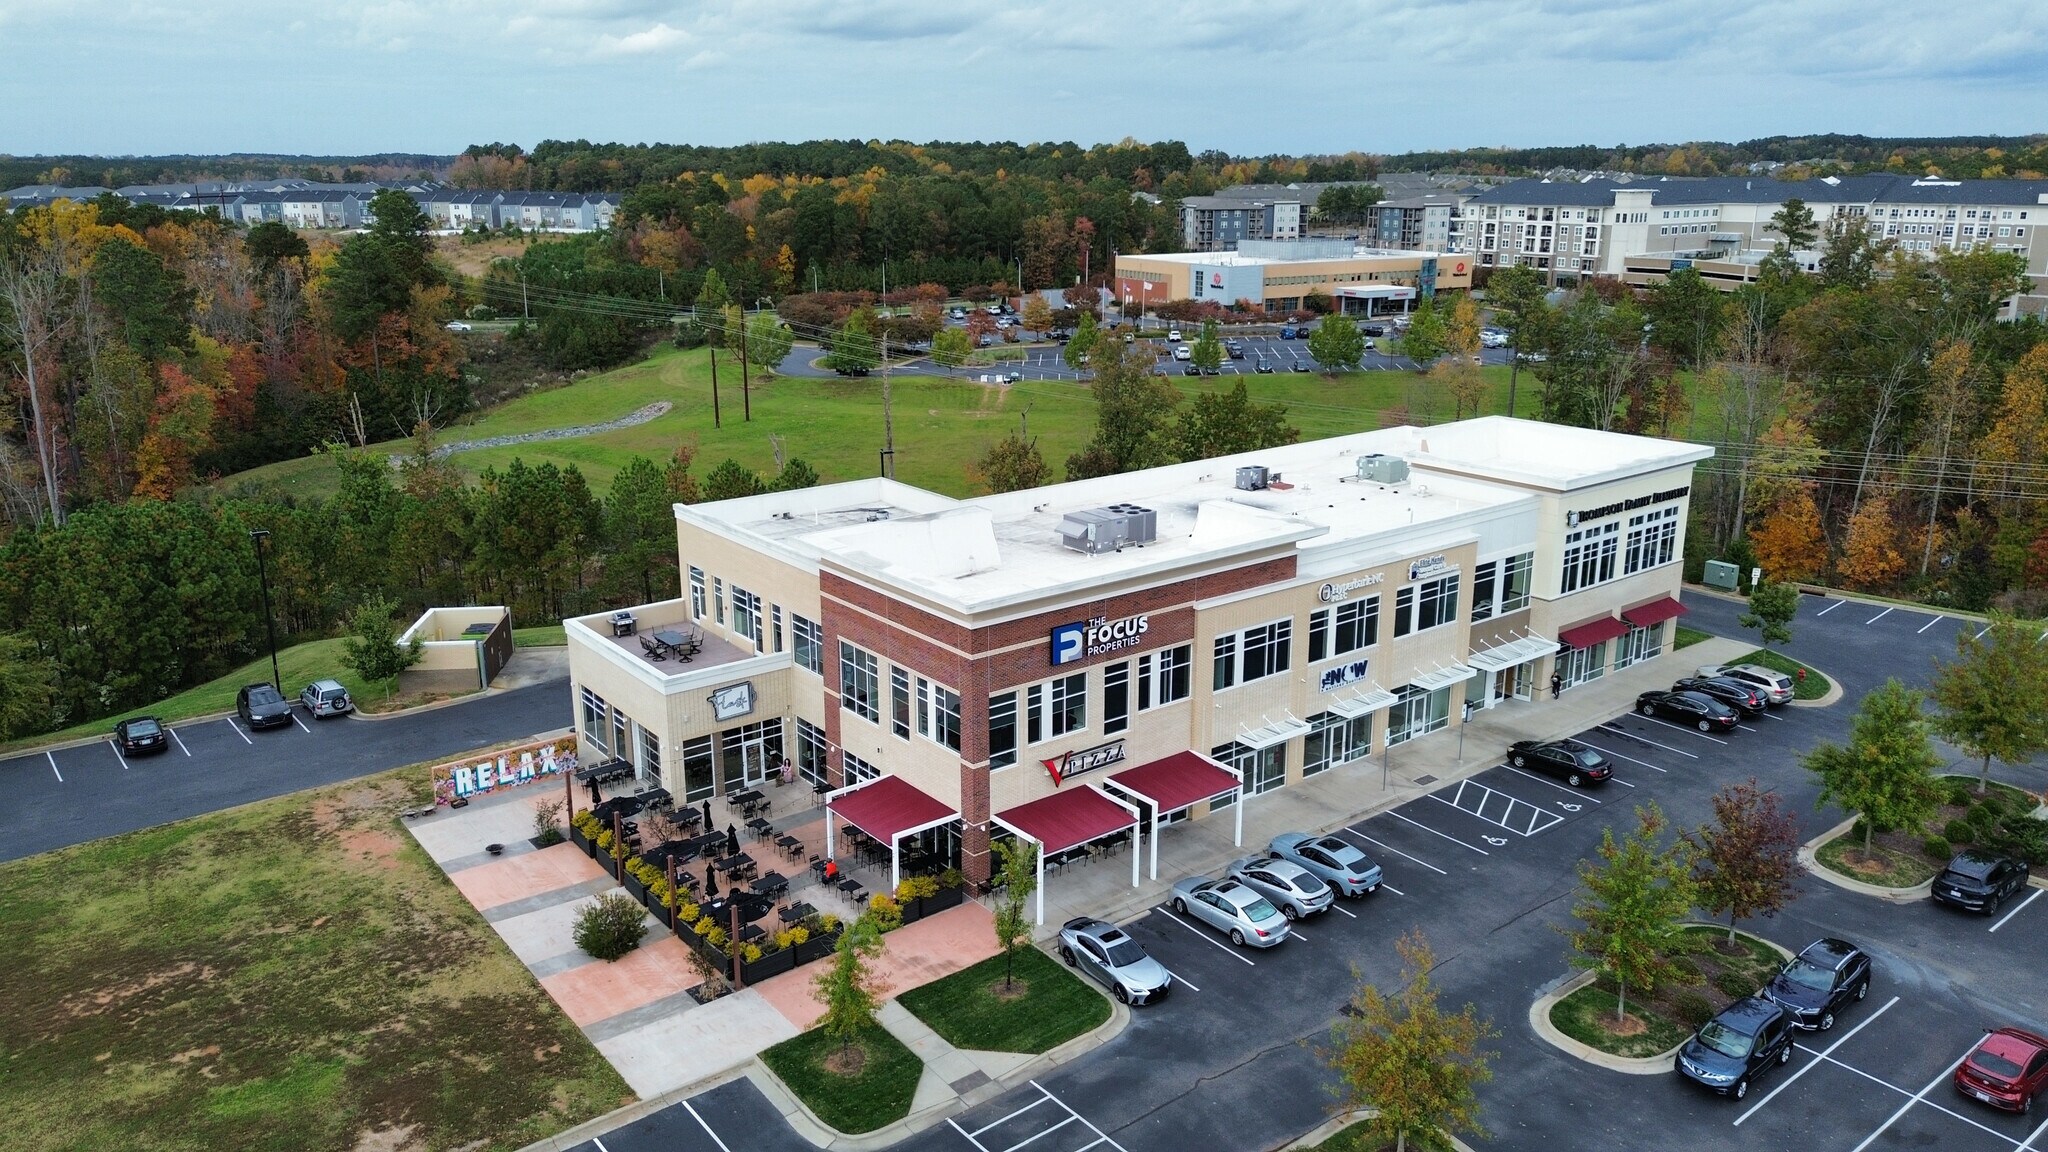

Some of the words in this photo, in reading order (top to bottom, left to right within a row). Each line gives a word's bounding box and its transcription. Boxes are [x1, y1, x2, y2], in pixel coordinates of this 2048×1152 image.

[1087, 615, 1149, 647] FOCUS
[1088, 616, 1106, 628] THE
[1087, 635, 1140, 657] PROPERTIES
[454, 744, 558, 797] RELAX
[1039, 750, 1074, 789] V
[1068, 744, 1126, 774] PIZZA
